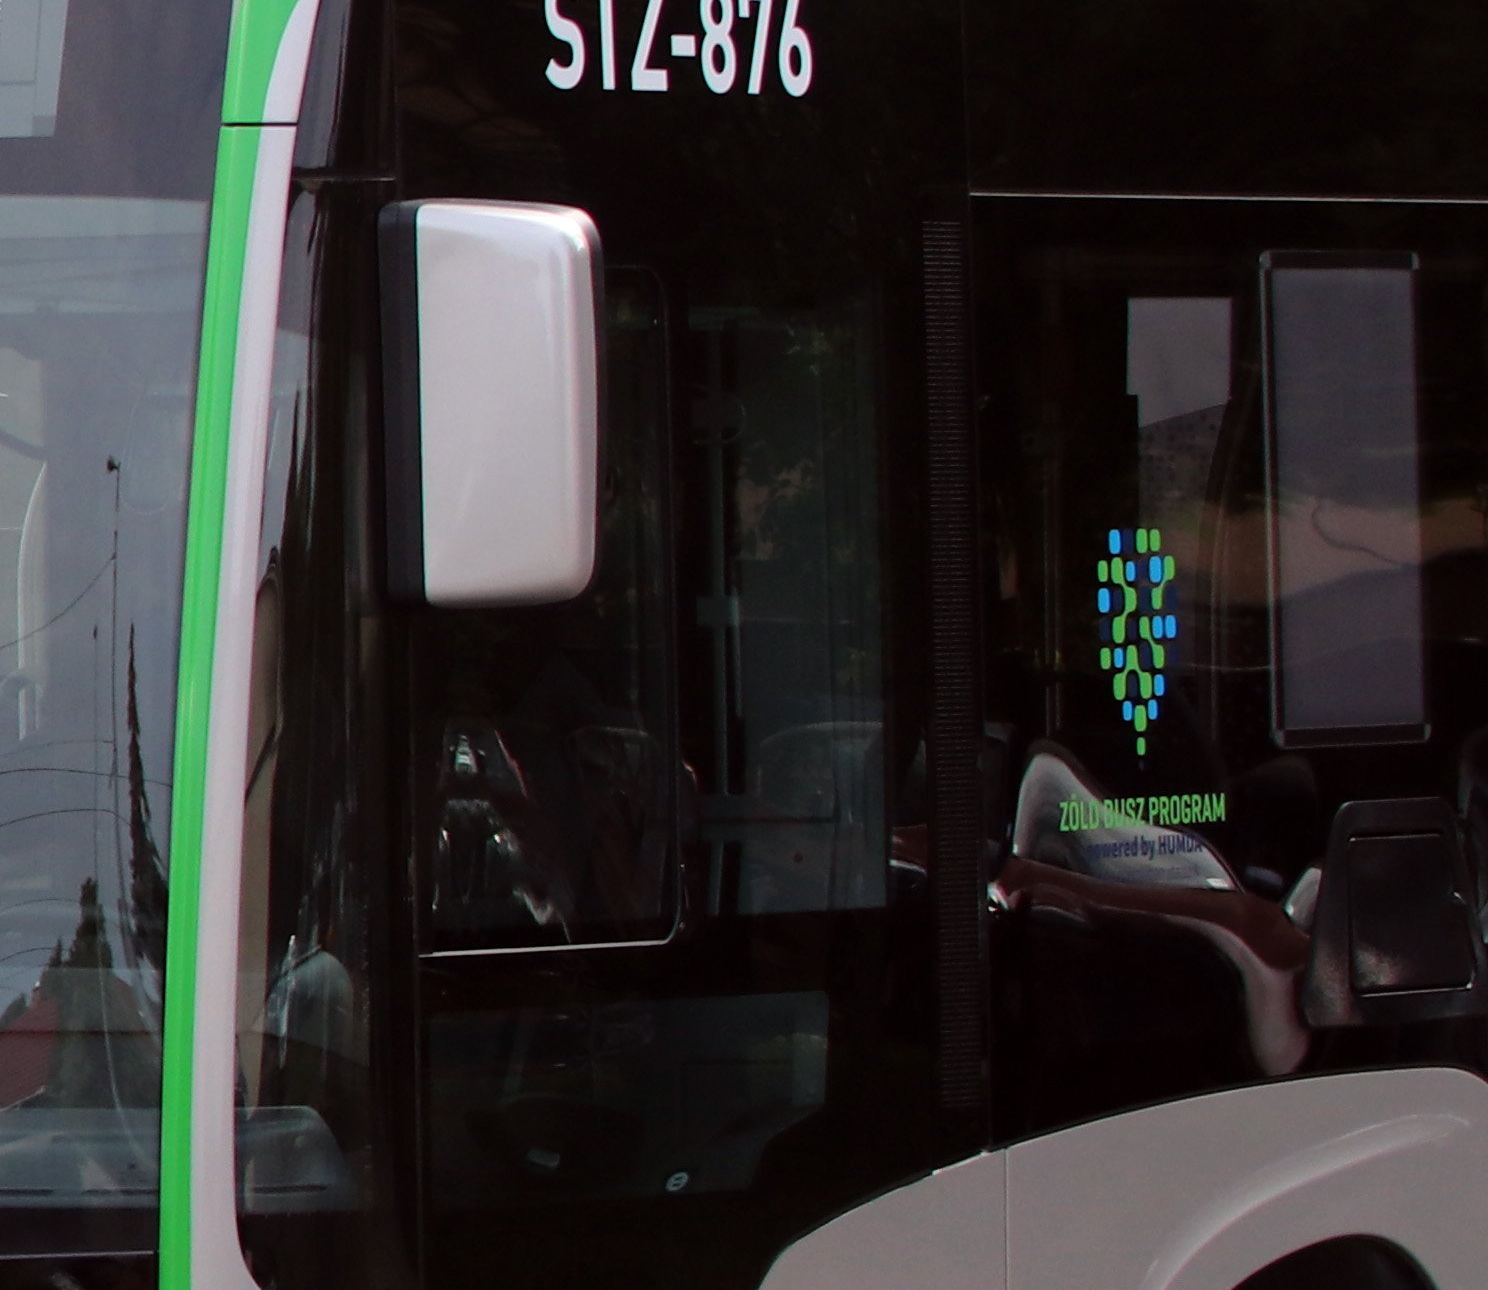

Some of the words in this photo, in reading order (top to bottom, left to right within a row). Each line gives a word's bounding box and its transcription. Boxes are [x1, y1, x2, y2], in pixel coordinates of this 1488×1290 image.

[1058, 793, 1100, 832] ZÖLD
[1103, 796, 1146, 830] BUSZ
[1148, 792, 1226, 826] PROGRAM
[1139, 835, 1155, 860] by
[1157, 832, 1205, 856] HUMDA
